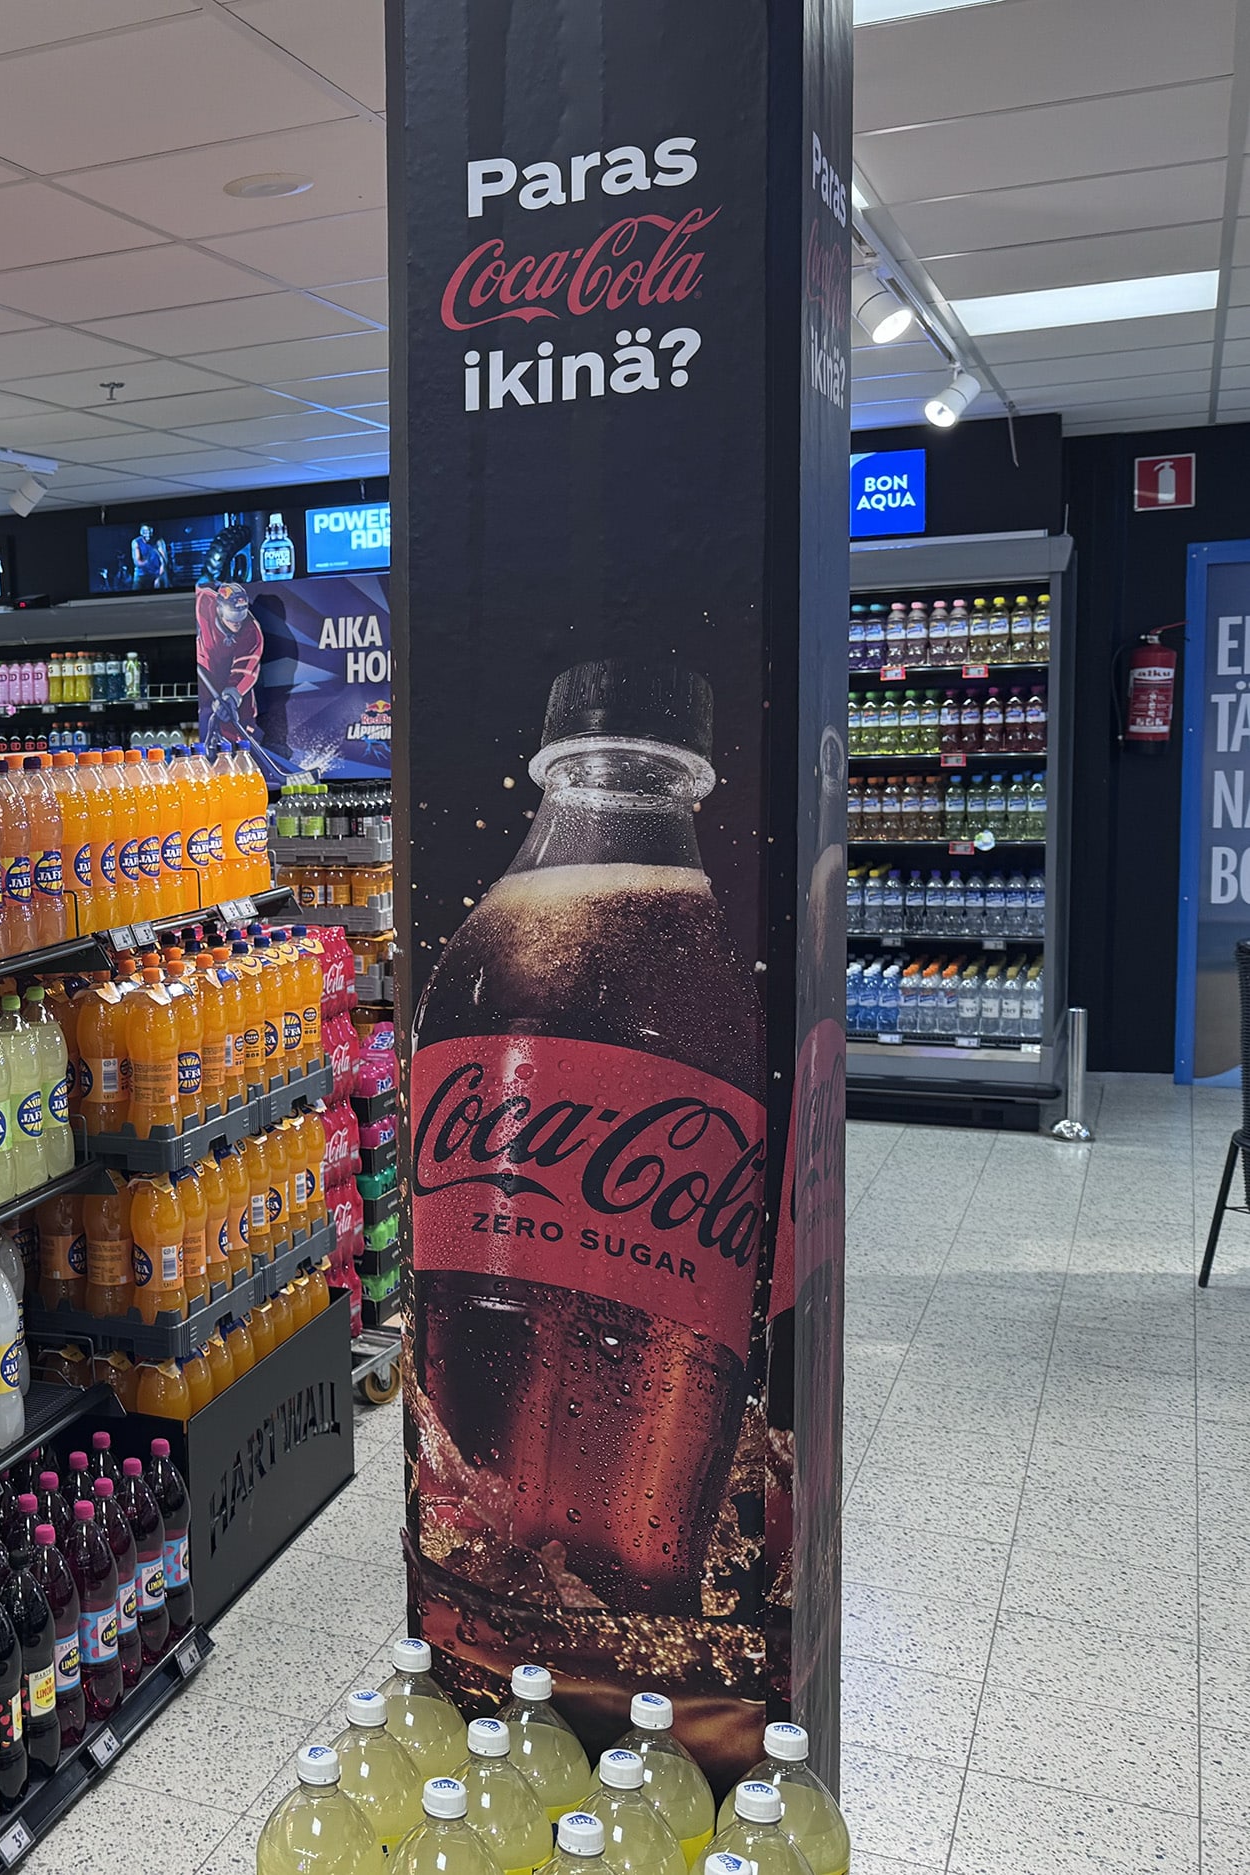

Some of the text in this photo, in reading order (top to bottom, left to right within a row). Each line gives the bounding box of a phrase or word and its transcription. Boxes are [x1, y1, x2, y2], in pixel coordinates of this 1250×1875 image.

[467, 136, 698, 218] Paras
[812, 130, 847, 228] Paras
[440, 205, 723, 331] Coca-Cola
[464, 327, 702, 412] ikinä?
[811, 325, 846, 410] ikinä?
[856, 492, 916, 511] AQUA
[864, 473, 909, 493] BON
[318, 615, 383, 649] AIKA
[412, 1062, 768, 1268] Coca-Cola
[471, 1211, 697, 1283] ZERO SUGAR
